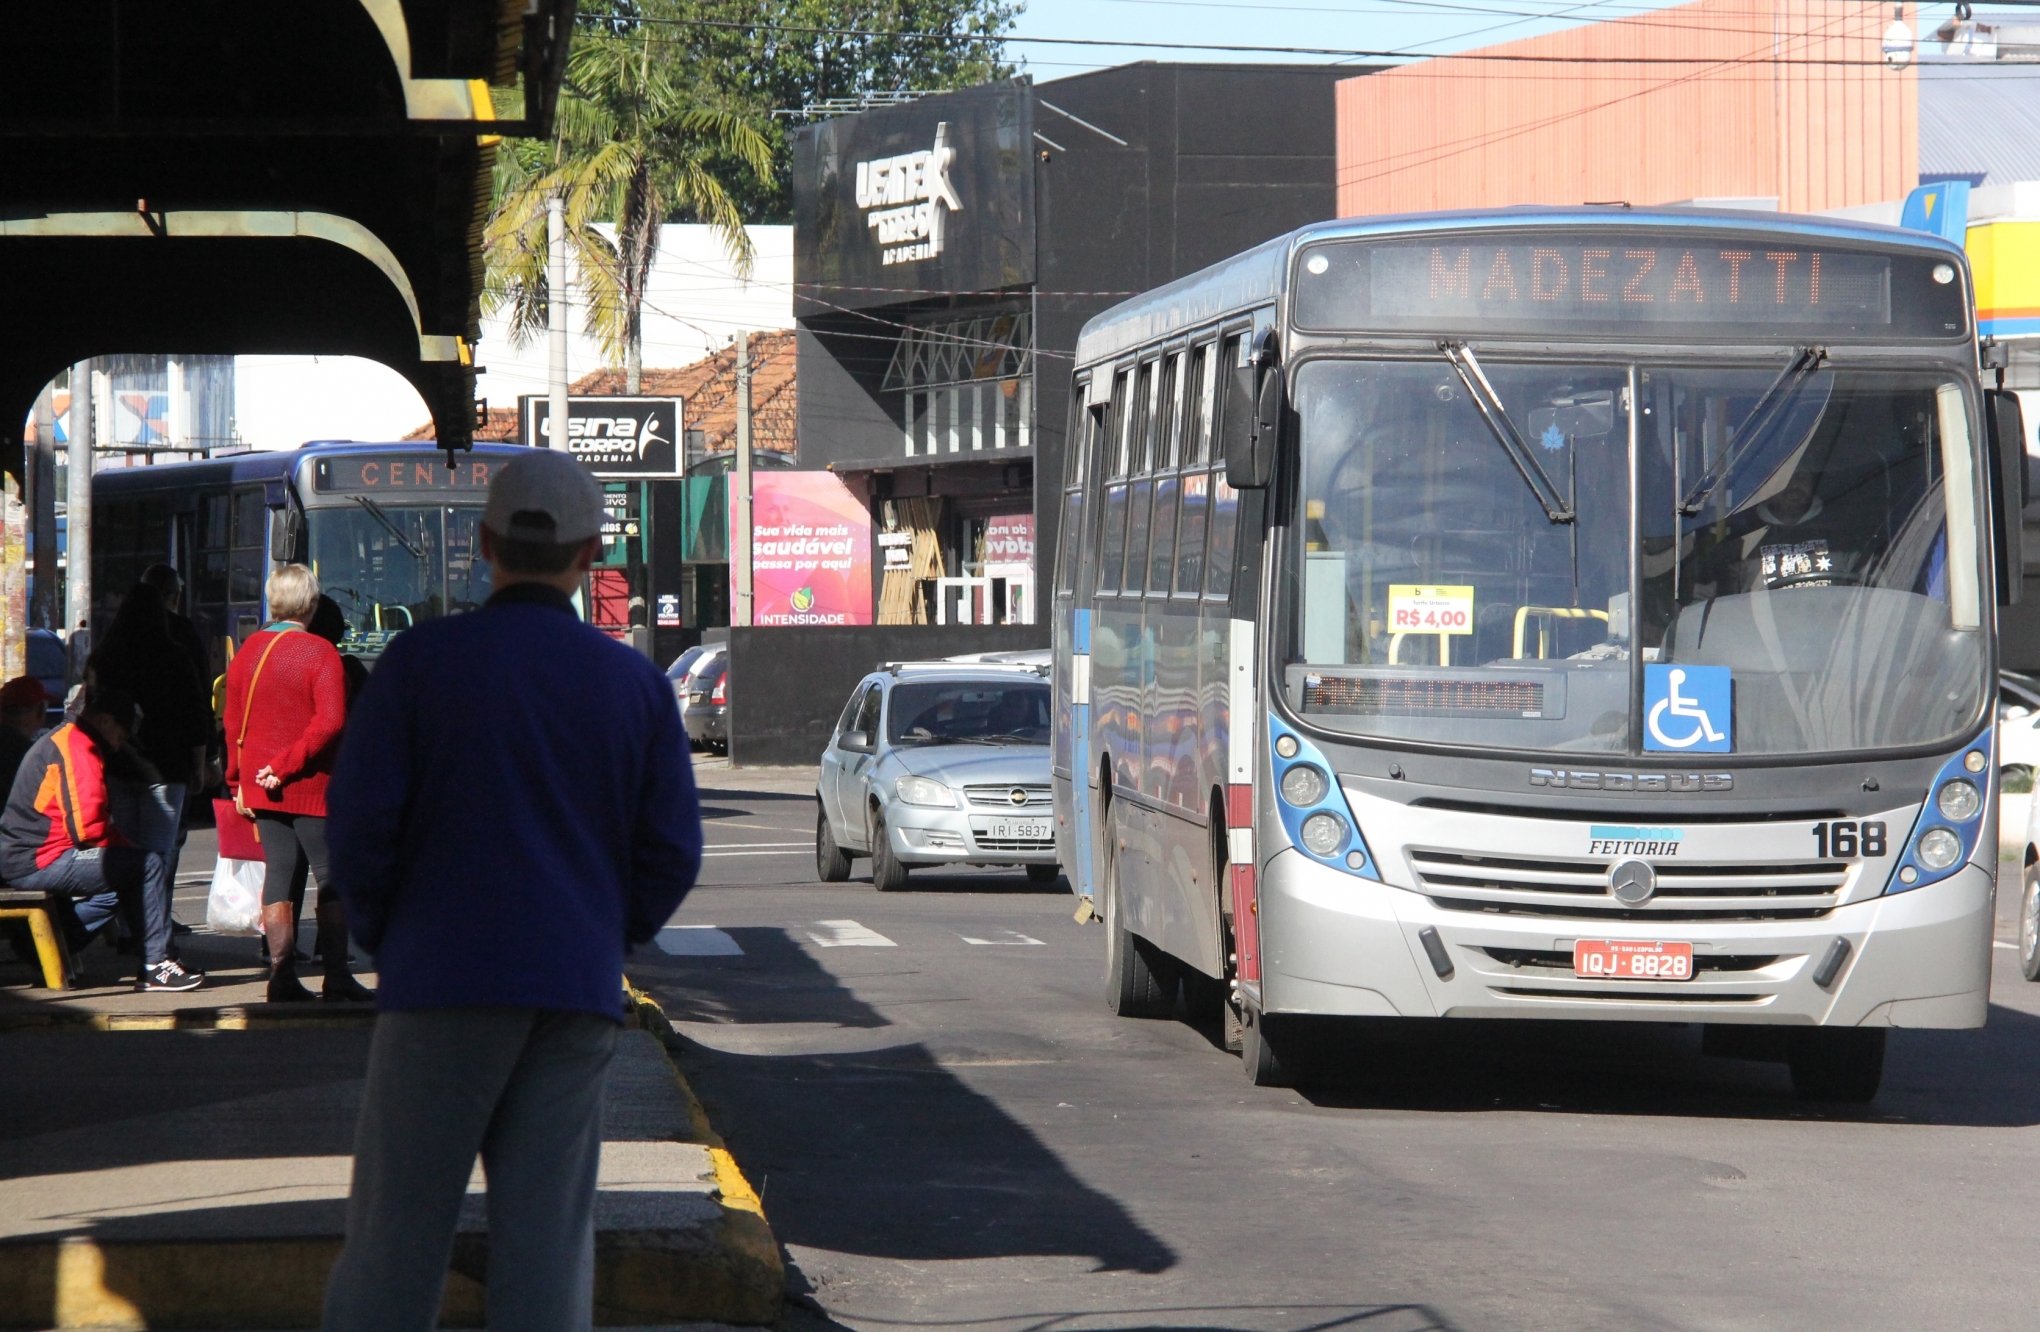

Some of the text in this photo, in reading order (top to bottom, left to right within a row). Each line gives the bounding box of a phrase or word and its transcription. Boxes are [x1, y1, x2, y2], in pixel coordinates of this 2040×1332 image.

[1430, 247, 1820, 303] MADEZATTI
[577, 454, 633, 462] CADEMIA
[361, 462, 508, 486] CENTR
[753, 524, 848, 537] Sua vida mais
[752, 538, 853, 556] saudável
[752, 557, 852, 571] passa por aqui
[760, 614, 845, 625] INTENSIDADE
[1396, 608, 1466, 628] R$ 4,00
[1529, 768, 1734, 792] NEOBUS
[1588, 840, 1680, 855] FEITORIA
[1812, 821, 1887, 858] 168
